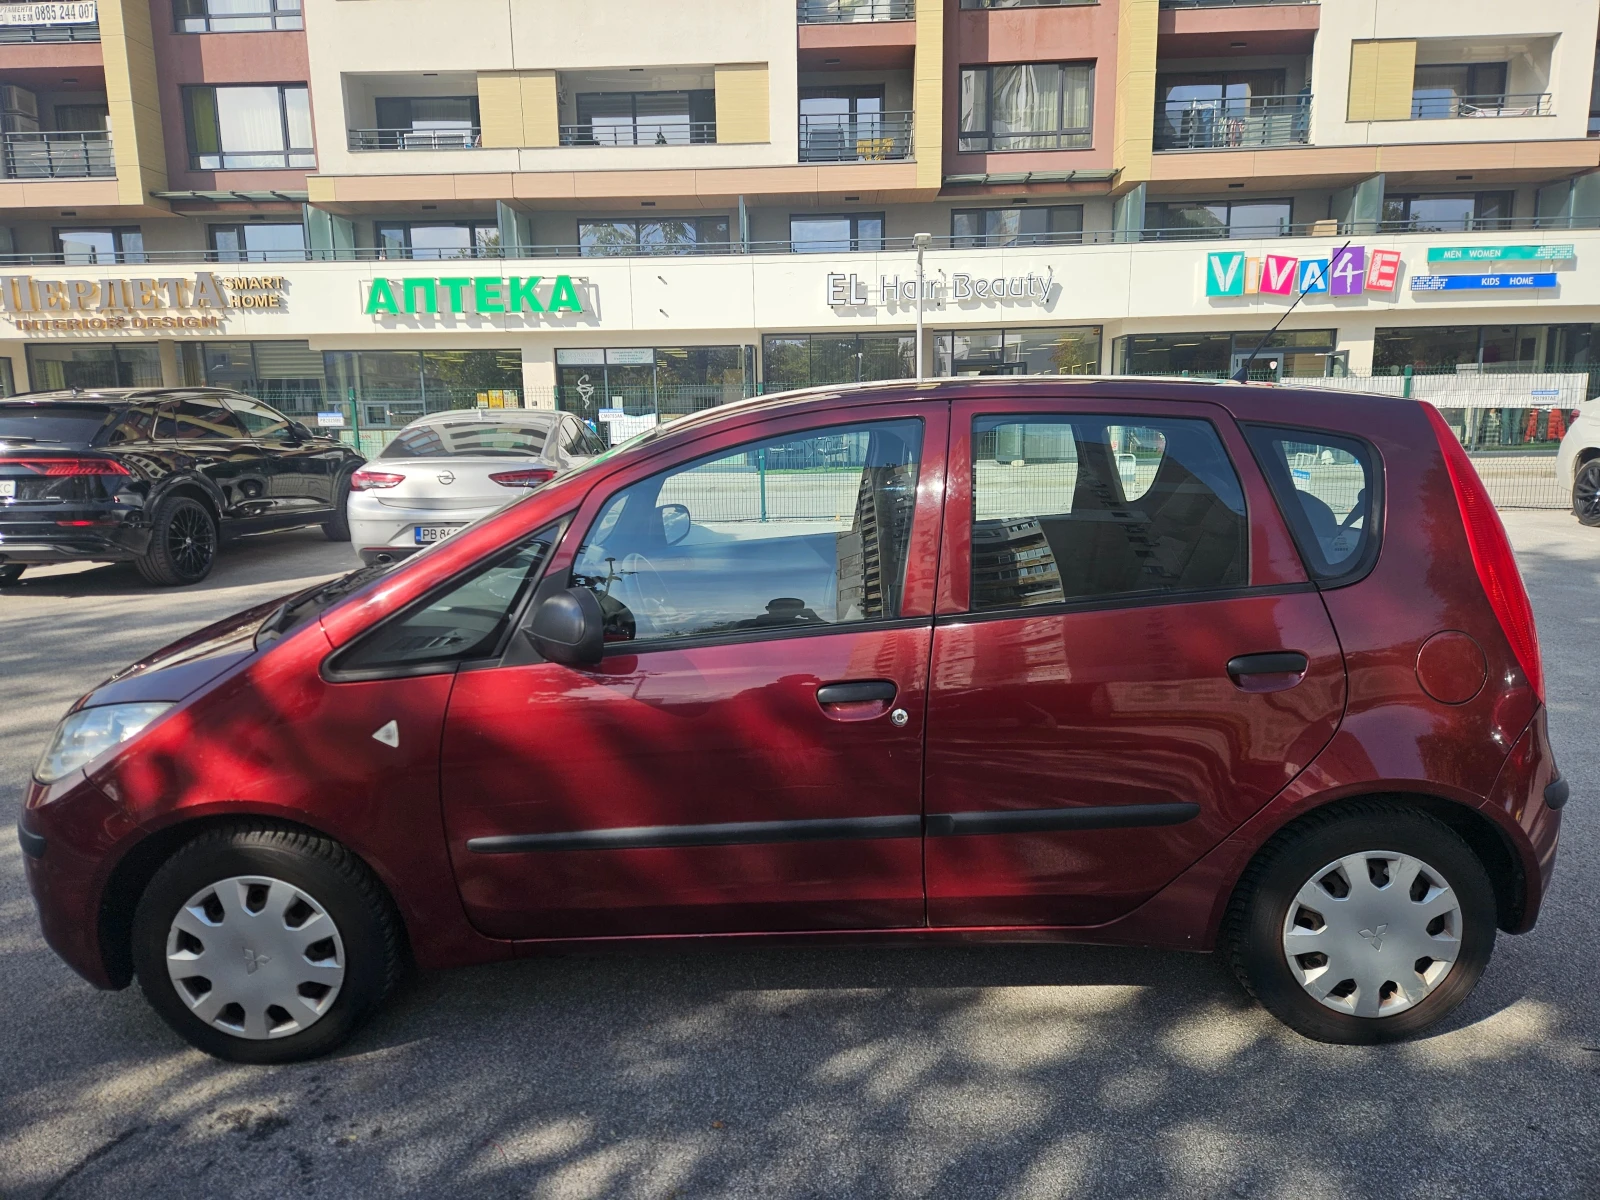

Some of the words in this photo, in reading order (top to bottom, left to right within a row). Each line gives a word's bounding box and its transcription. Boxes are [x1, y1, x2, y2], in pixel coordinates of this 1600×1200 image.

[12, 14, 33, 22] НАЕМ
[35, 5, 57, 20] 0885
[60, 5, 76, 20] 244
[79, 4, 94, 19] 007
[1443, 250, 1462, 259] MEN
[1469, 249, 1502, 258] WOMEN
[223, 276, 284, 290] SMART
[1481, 277, 1500, 286] KIDS
[1509, 277, 1534, 285] HOME
[364, 275, 583, 315] АПТЕКА
[827, 273, 867, 306] EL
[880, 273, 939, 303] Hair
[952, 272, 1054, 303] Beauty
[229, 294, 281, 308] HOME
[15, 317, 124, 331] INTERIOR
[131, 316, 218, 330] DESIGN
